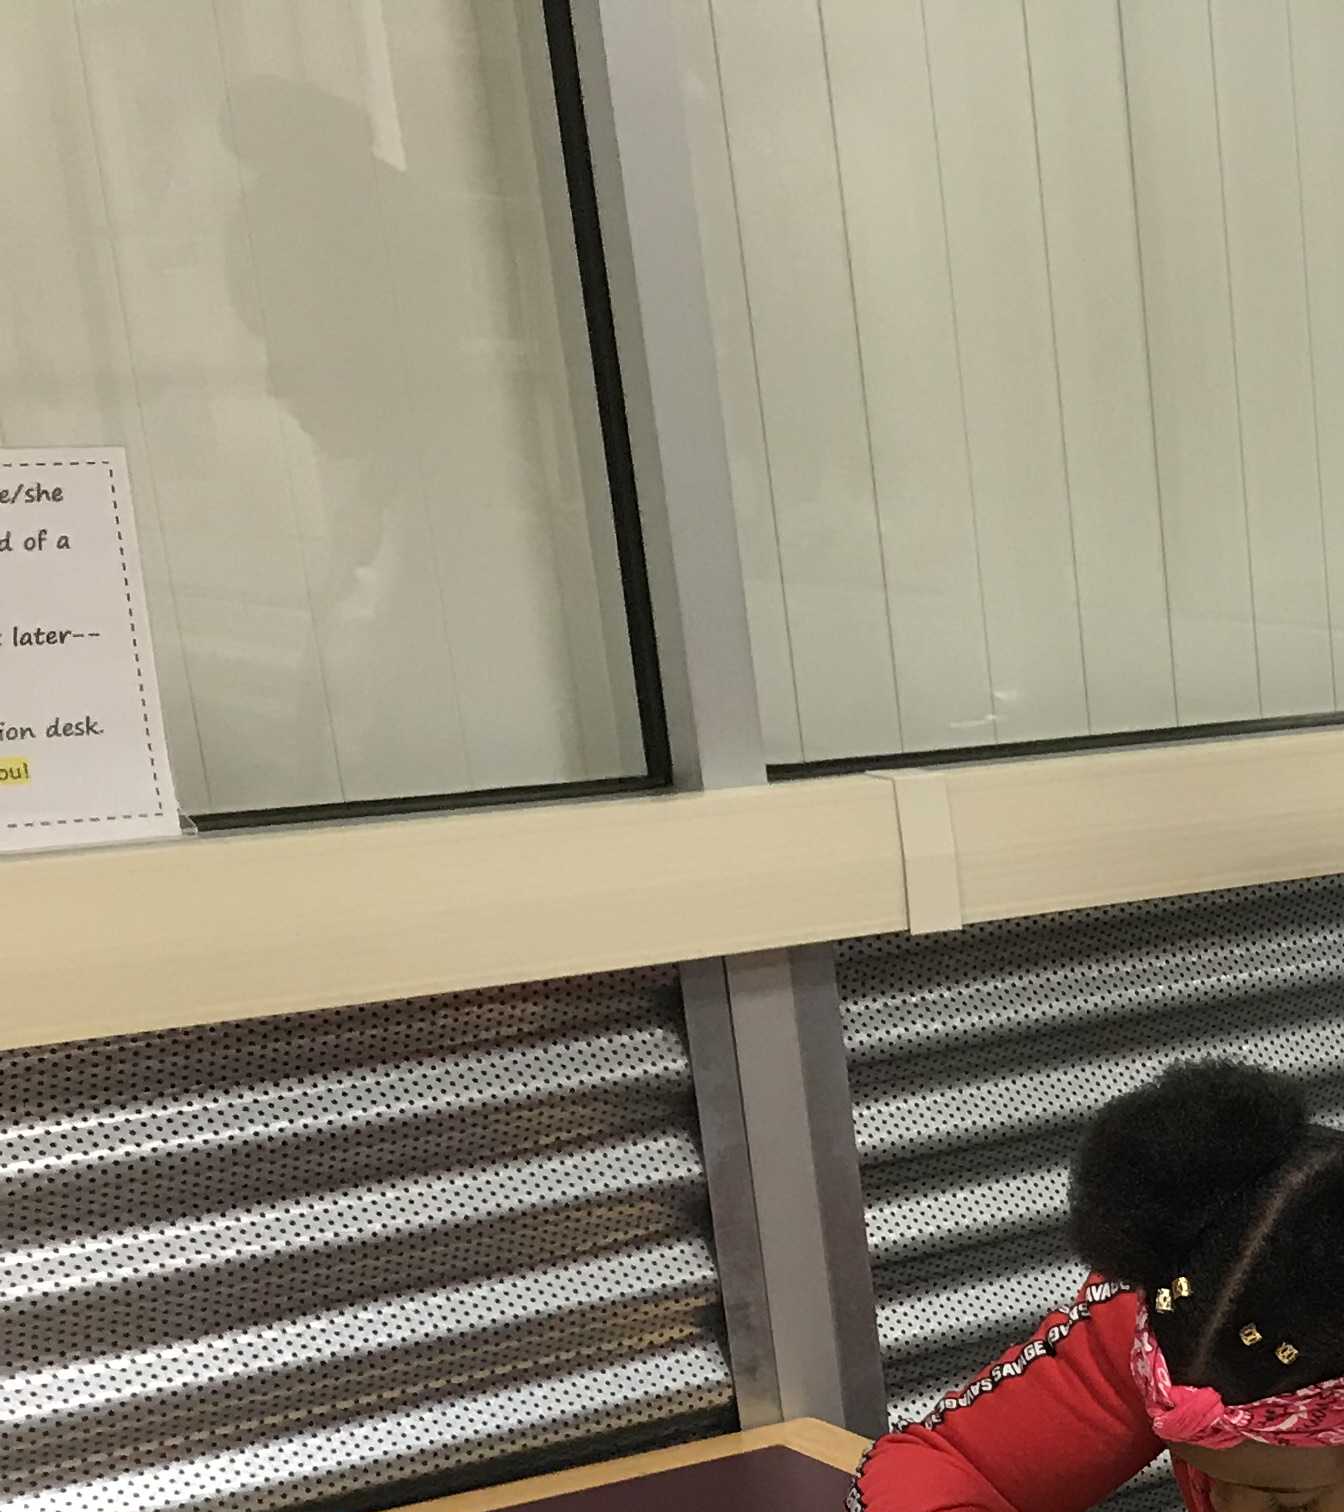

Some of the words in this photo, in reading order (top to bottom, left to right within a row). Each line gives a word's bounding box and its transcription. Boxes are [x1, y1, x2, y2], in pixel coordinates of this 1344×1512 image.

[0, 530, 12, 551] d
[24, 529, 47, 551] of
[56, 535, 71, 550] a
[0, 720, 36, 742] ion
[46, 715, 105, 739] desk.
[0, 762, 30, 781] ou!
